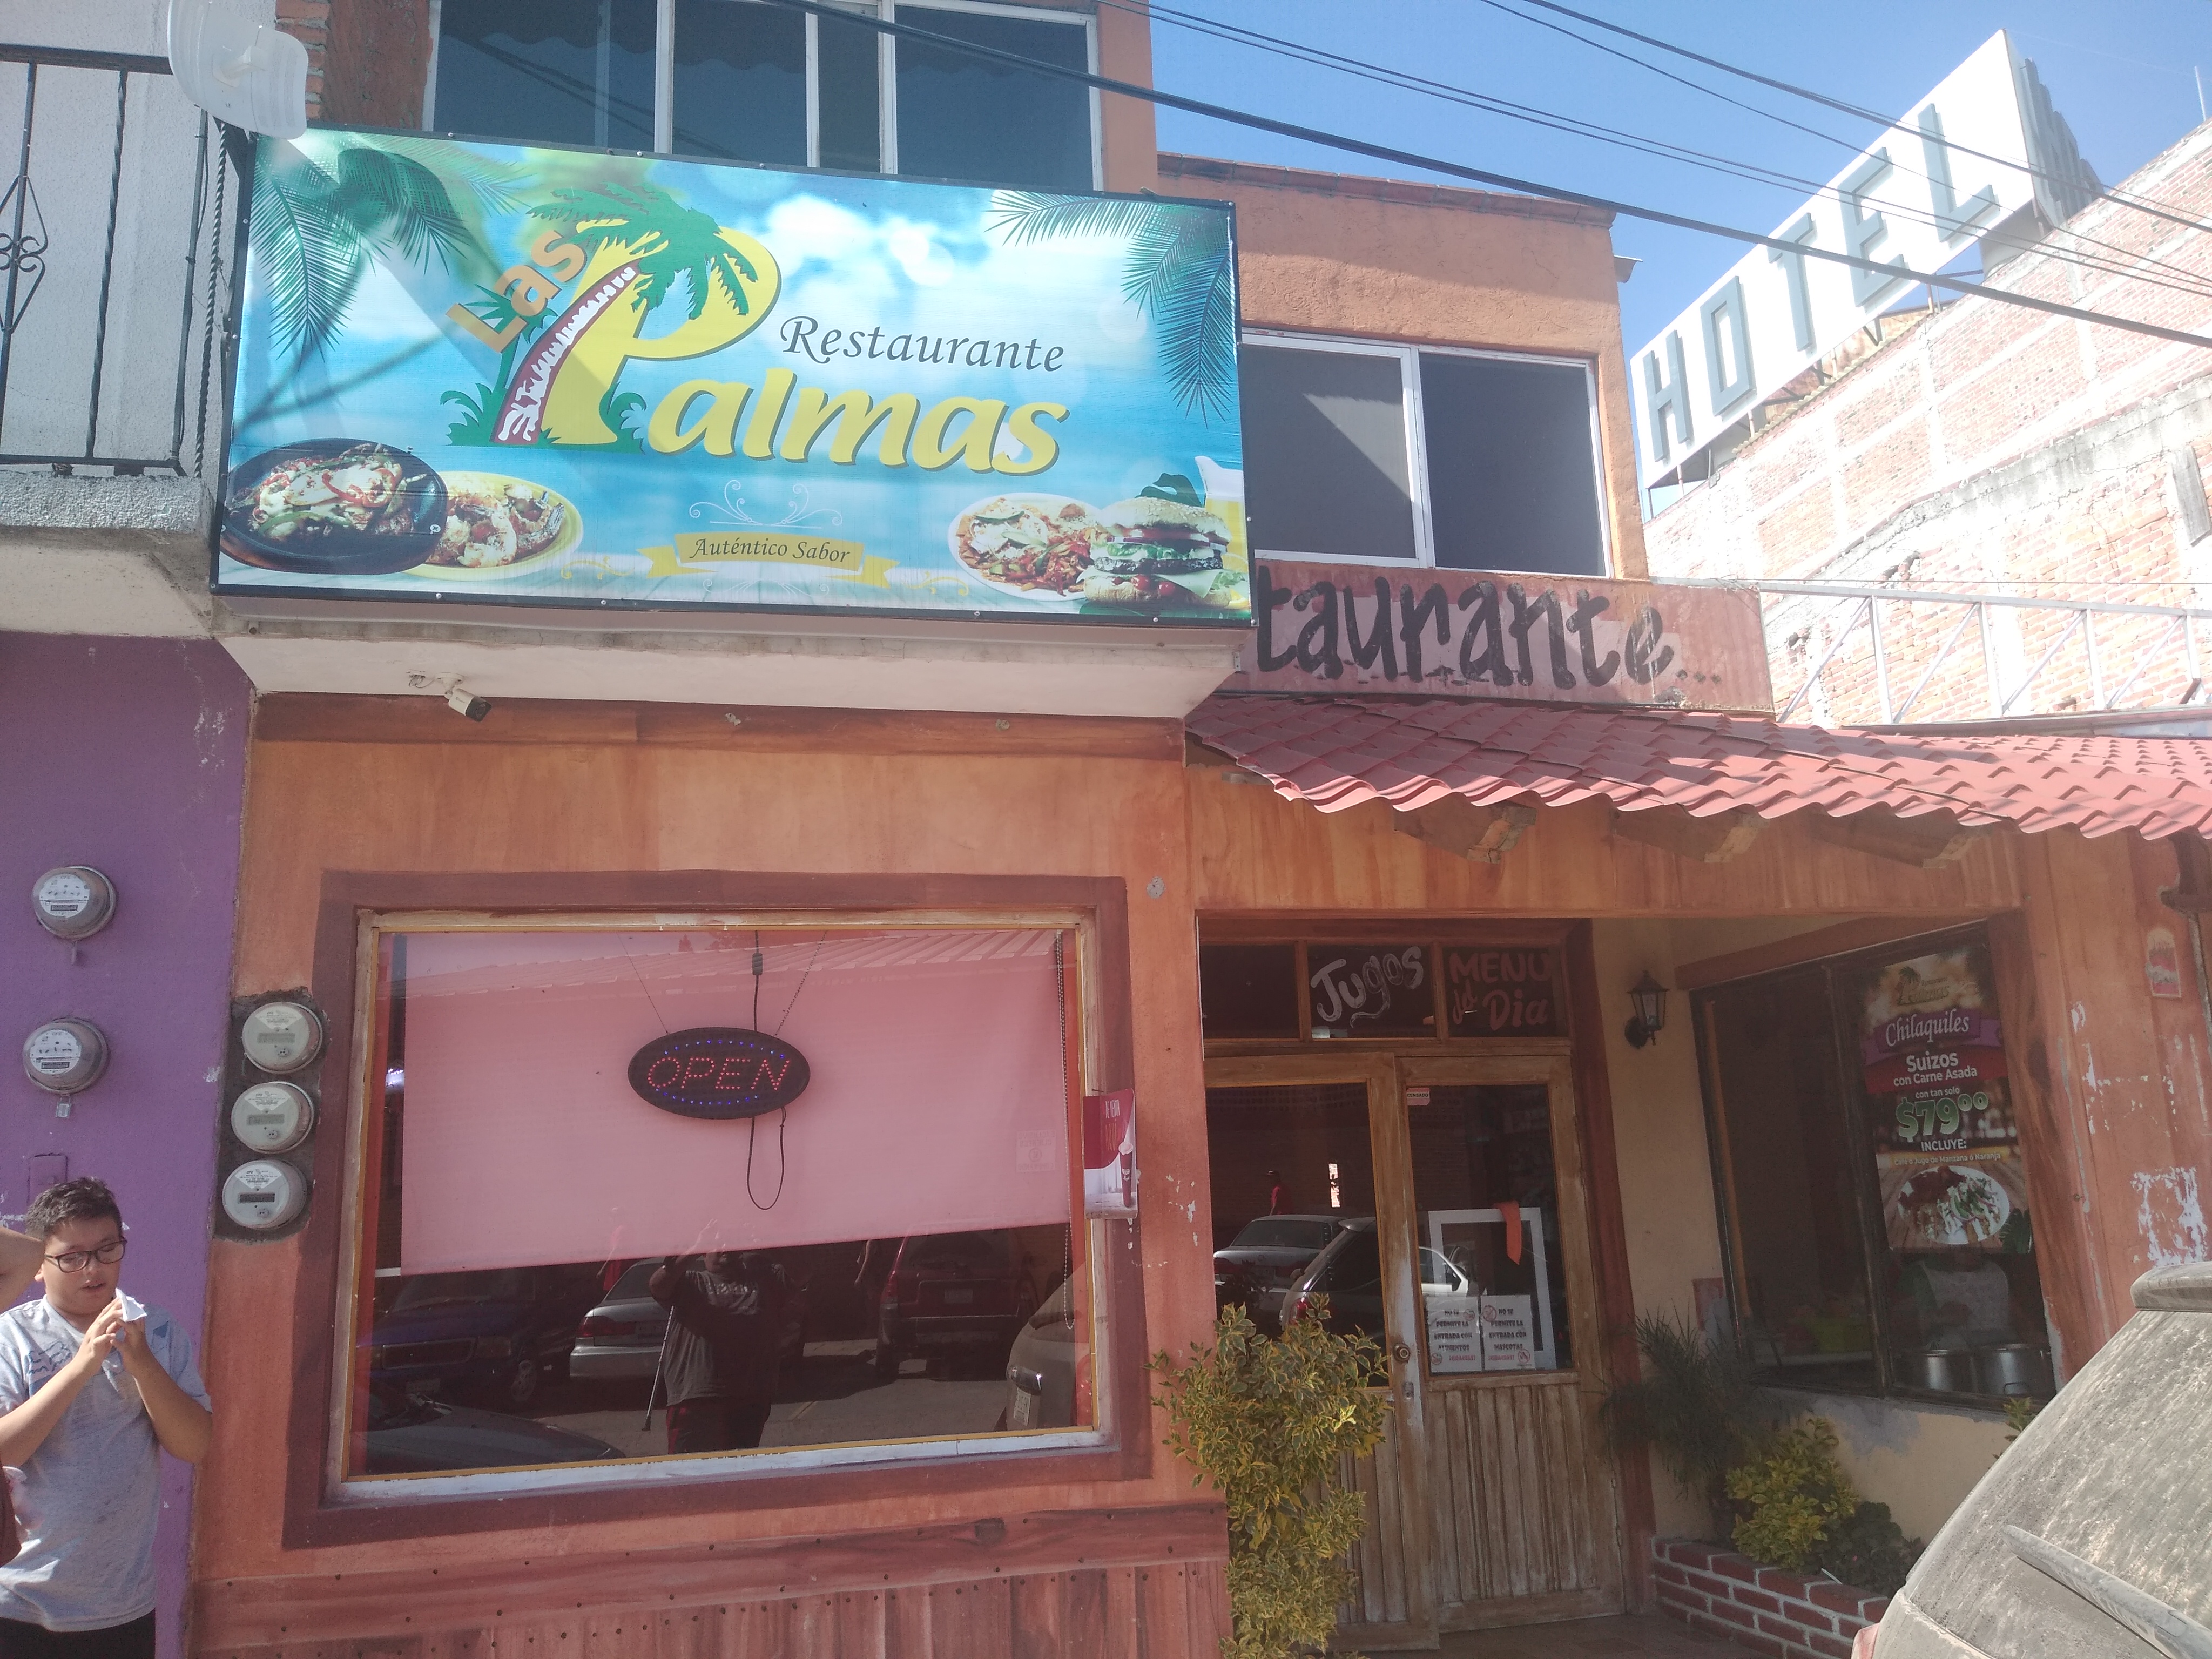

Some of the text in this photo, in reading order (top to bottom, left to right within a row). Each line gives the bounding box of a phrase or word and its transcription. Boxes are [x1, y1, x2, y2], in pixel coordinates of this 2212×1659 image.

[444, 230, 588, 354] Las
[1642, 103, 1999, 462] HOTEL
[780, 315, 1064, 373] Restaurante
[689, 537, 851, 563] Auténtico Sabor
[1449, 952, 1552, 983] MENU
[1311, 946, 1424, 1029] Jugos
[1482, 988, 1548, 1031] Dia
[1885, 1008, 1970, 1047] Chilaquiles
[648, 1057, 790, 1090] OPEN
[1893, 1065, 1978, 1087] con Carne Asada
[1906, 1050, 1959, 1073] Suizos
[1930, 1089, 1943, 1097] tan
[1944, 1086, 1960, 1095] solo
[1914, 1157, 1929, 1165] Jugo
[1939, 1155, 1968, 1163] Manzana
[1975, 1152, 2001, 1161] Naranja
[1920, 1138, 1967, 1152] INCLUYE:
